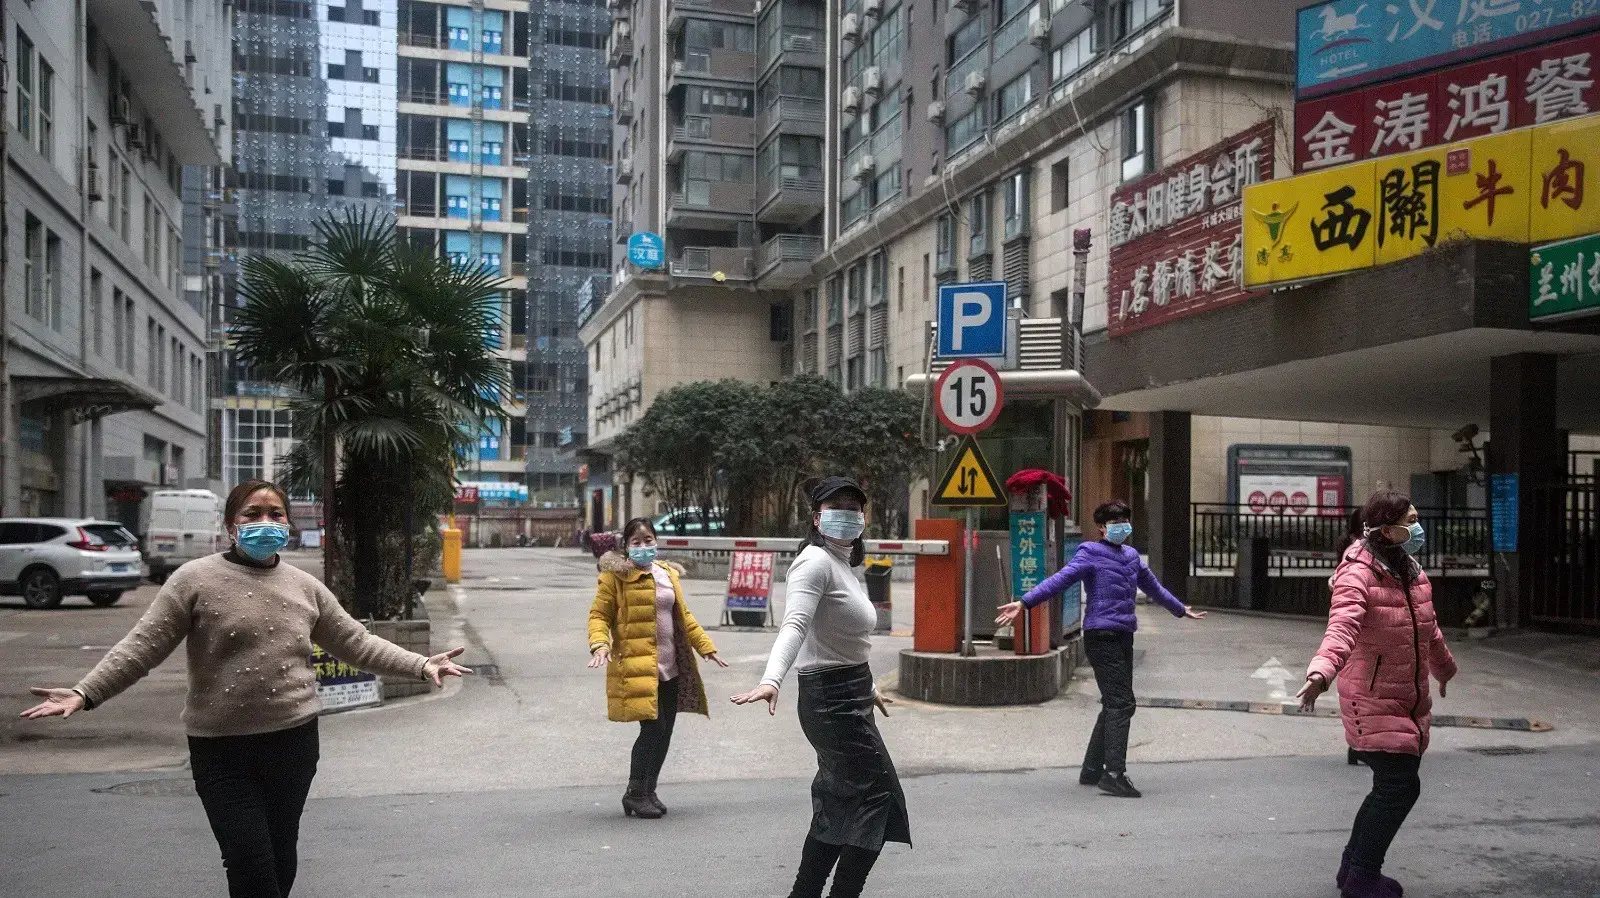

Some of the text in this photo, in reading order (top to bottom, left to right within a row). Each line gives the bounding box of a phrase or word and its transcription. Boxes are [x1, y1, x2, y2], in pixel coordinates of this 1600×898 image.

[1386, 0, 1542, 43] 汉庭
[1319, 49, 1359, 66] HOTEL
[1302, 51, 1595, 170] 金涛鸿餐
[1109, 137, 1263, 247] 鑫太阳健身会所
[633, 247, 659, 260] 汉庭
[952, 291, 992, 351] P
[949, 375, 987, 418] 15
[1018, 517, 1038, 592] 对外停车
